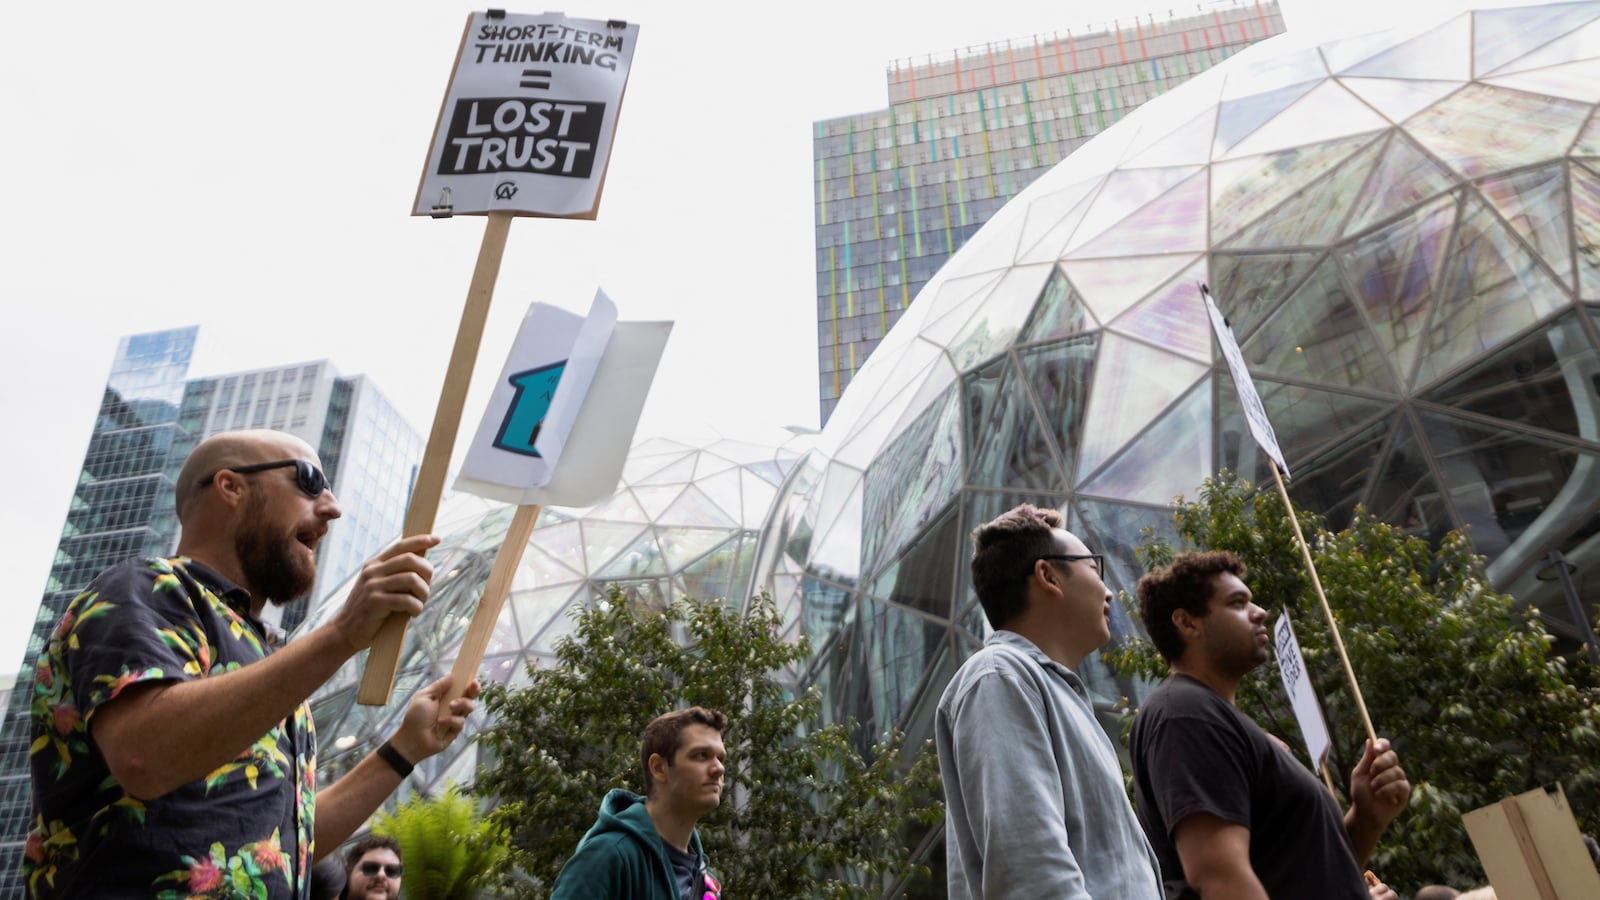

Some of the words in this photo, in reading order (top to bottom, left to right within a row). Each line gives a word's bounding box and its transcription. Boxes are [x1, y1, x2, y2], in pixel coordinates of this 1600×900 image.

[478, 24, 623, 51] SHORT-TERM
[475, 42, 618, 71] THINKING
[467, 100, 586, 136] LOST
[452, 137, 591, 172] TRUST
